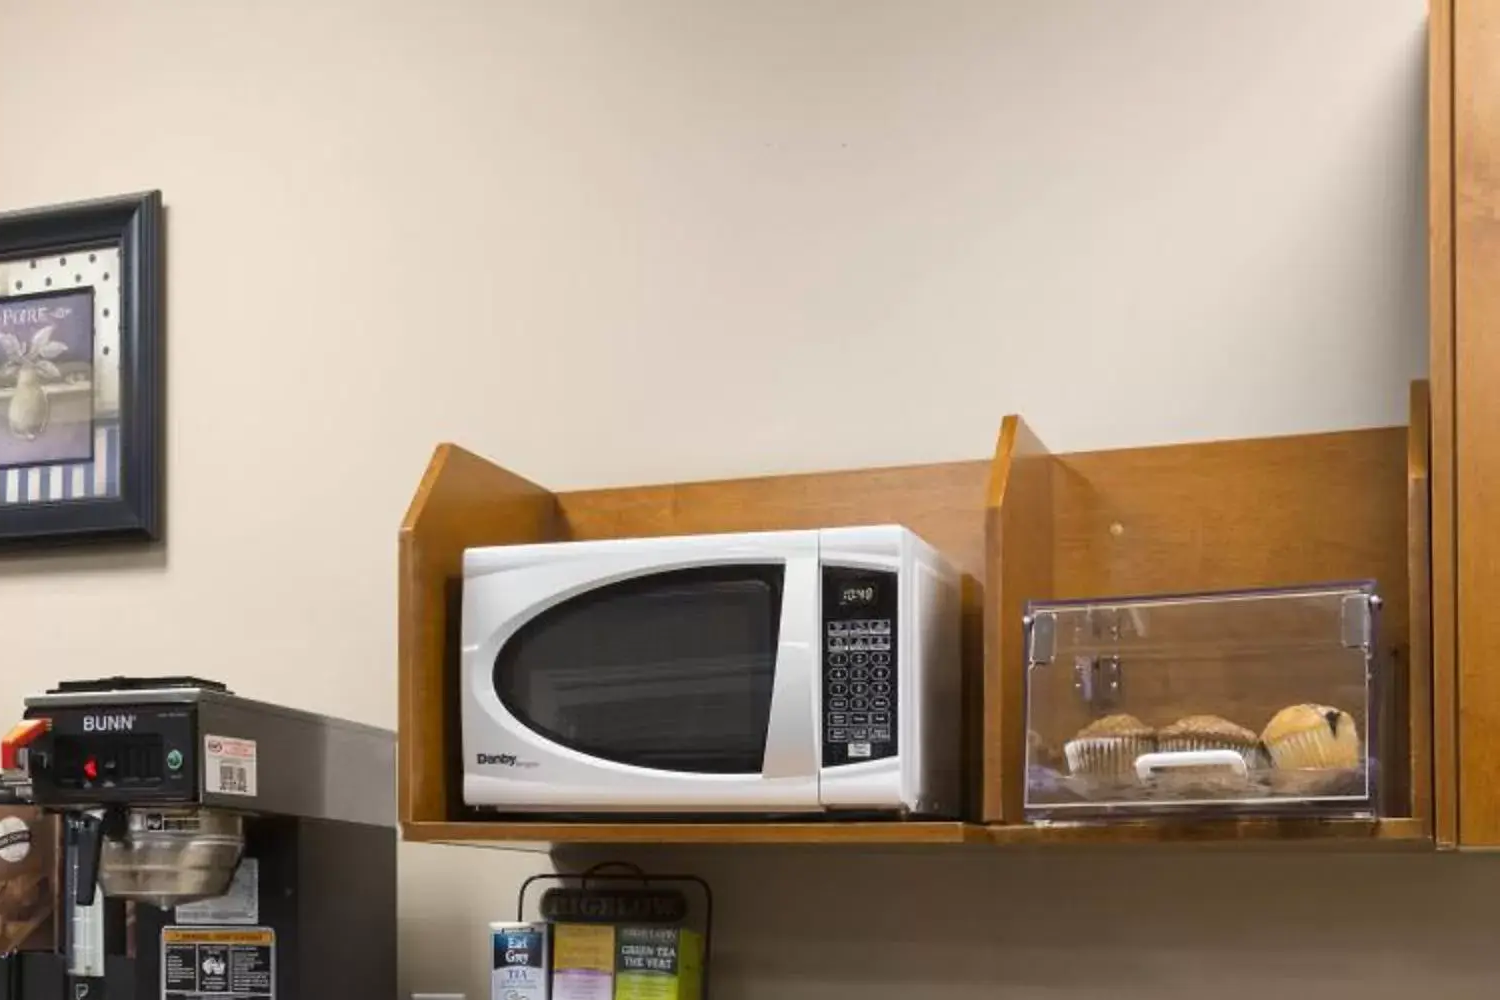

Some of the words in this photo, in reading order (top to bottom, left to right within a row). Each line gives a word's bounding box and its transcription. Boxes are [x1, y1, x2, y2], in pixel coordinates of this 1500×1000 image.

[83, 714, 133, 732] BUNN
[477, 753, 517, 767] Danby
[621, 945, 656, 957] GREEN
[657, 947, 677, 958] TEA
